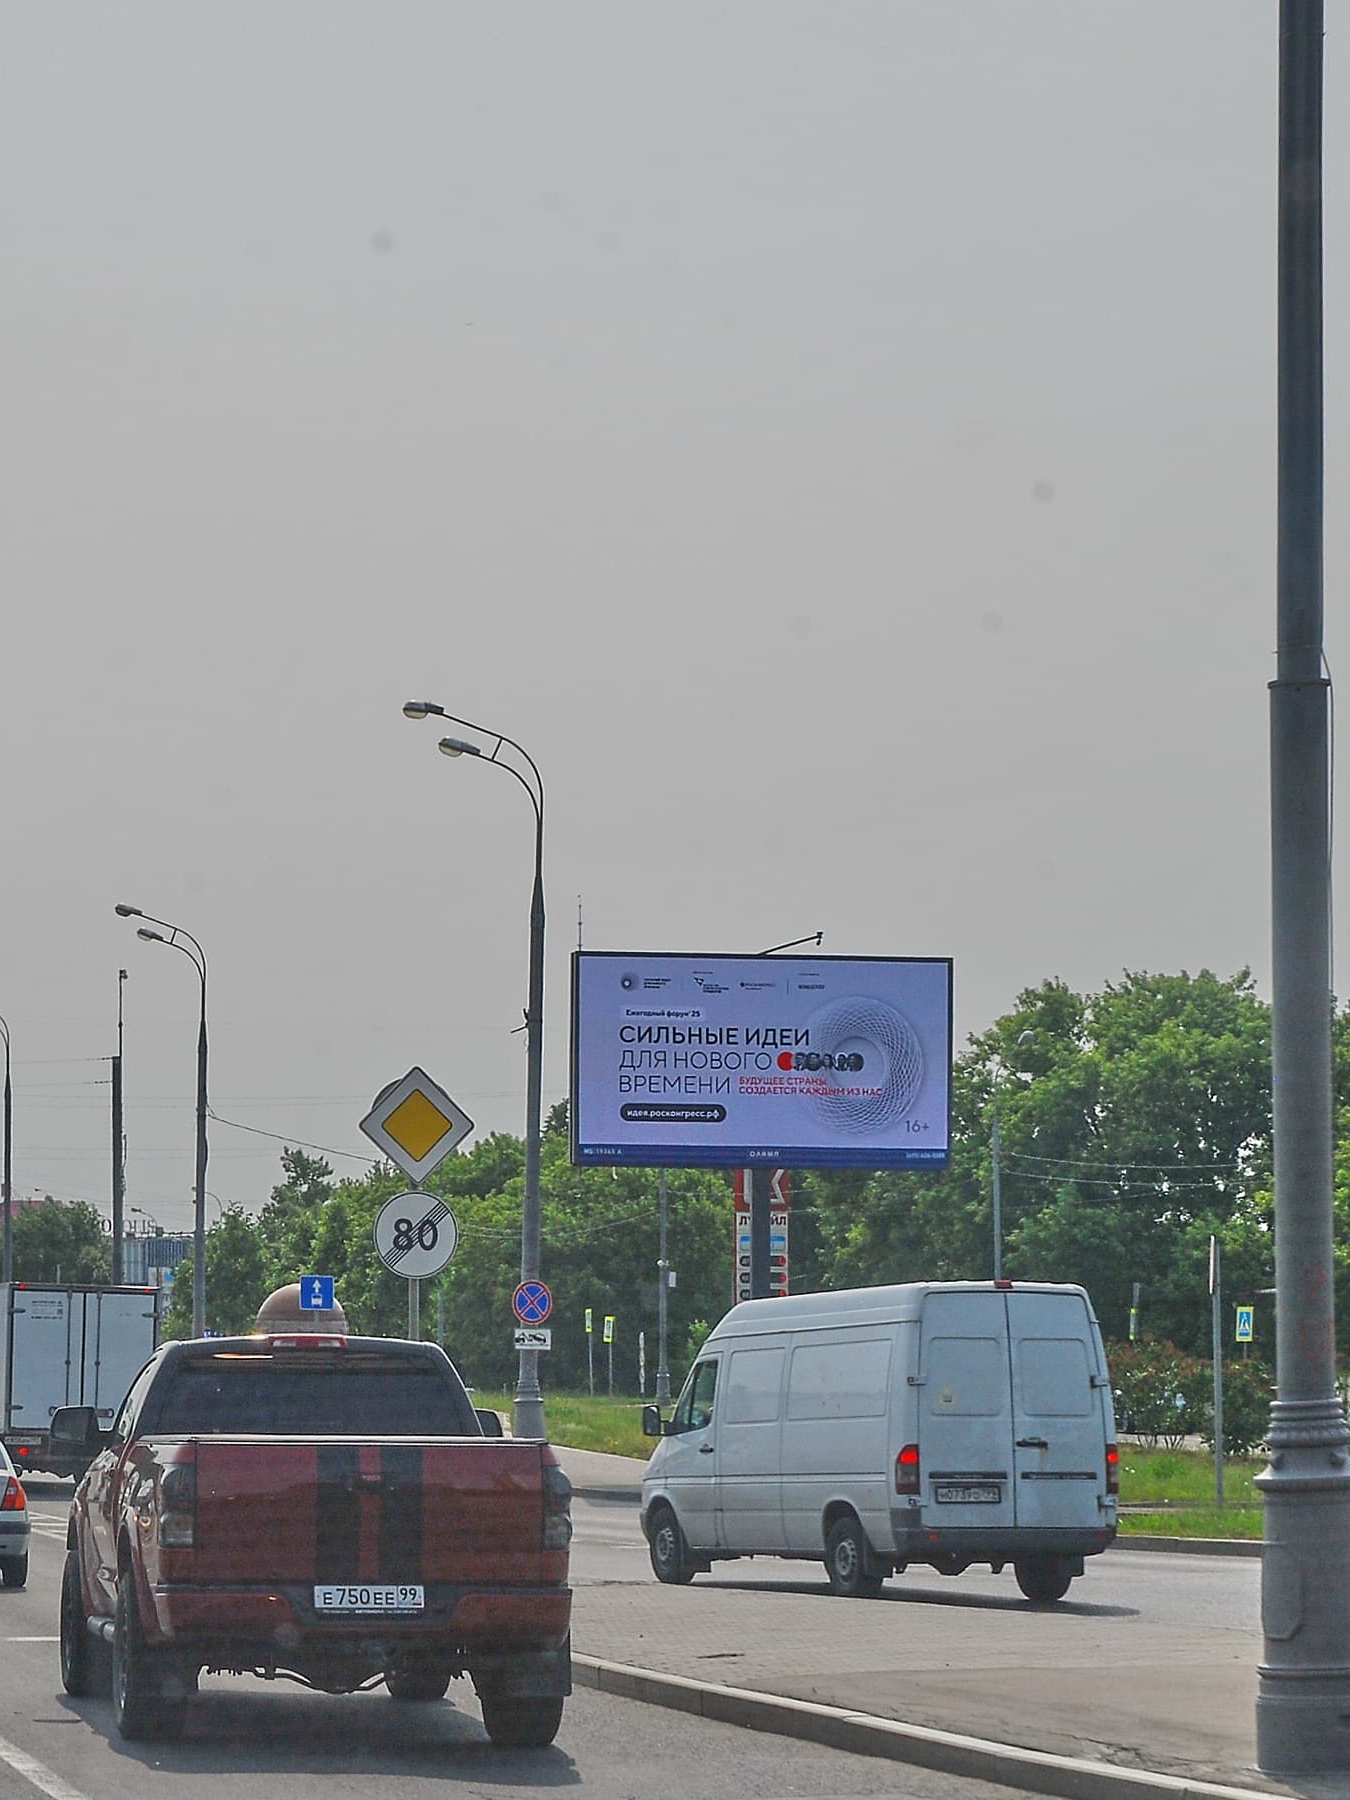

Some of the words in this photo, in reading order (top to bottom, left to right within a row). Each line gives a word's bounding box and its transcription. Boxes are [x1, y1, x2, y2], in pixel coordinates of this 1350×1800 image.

[619, 1025, 739, 1045] СИЛЬНЫЕ
[745, 1028, 810, 1049] ИДЕИ
[619, 1051, 667, 1071] ДЛЯ
[674, 1051, 772, 1071] НОВОГО
[619, 1076, 731, 1095] ВРЕМЕНИ
[739, 1077, 785, 1087] БУДУЩЕЕ
[786, 1078, 827, 1087] СТРАНЫ
[739, 1086, 798, 1096] СОЗДАЕТСЯ
[800, 1087, 845, 1097] КАЖДЫМ
[847, 1088, 861, 1096] ИЗ
[862, 1088, 883, 1097] НАС
[906, 1120, 929, 1133] 16+
[393, 1218, 438, 1251] 80
[323, 1588, 395, 1605] Е750ЕЕ
[399, 1587, 417, 1601] 99
